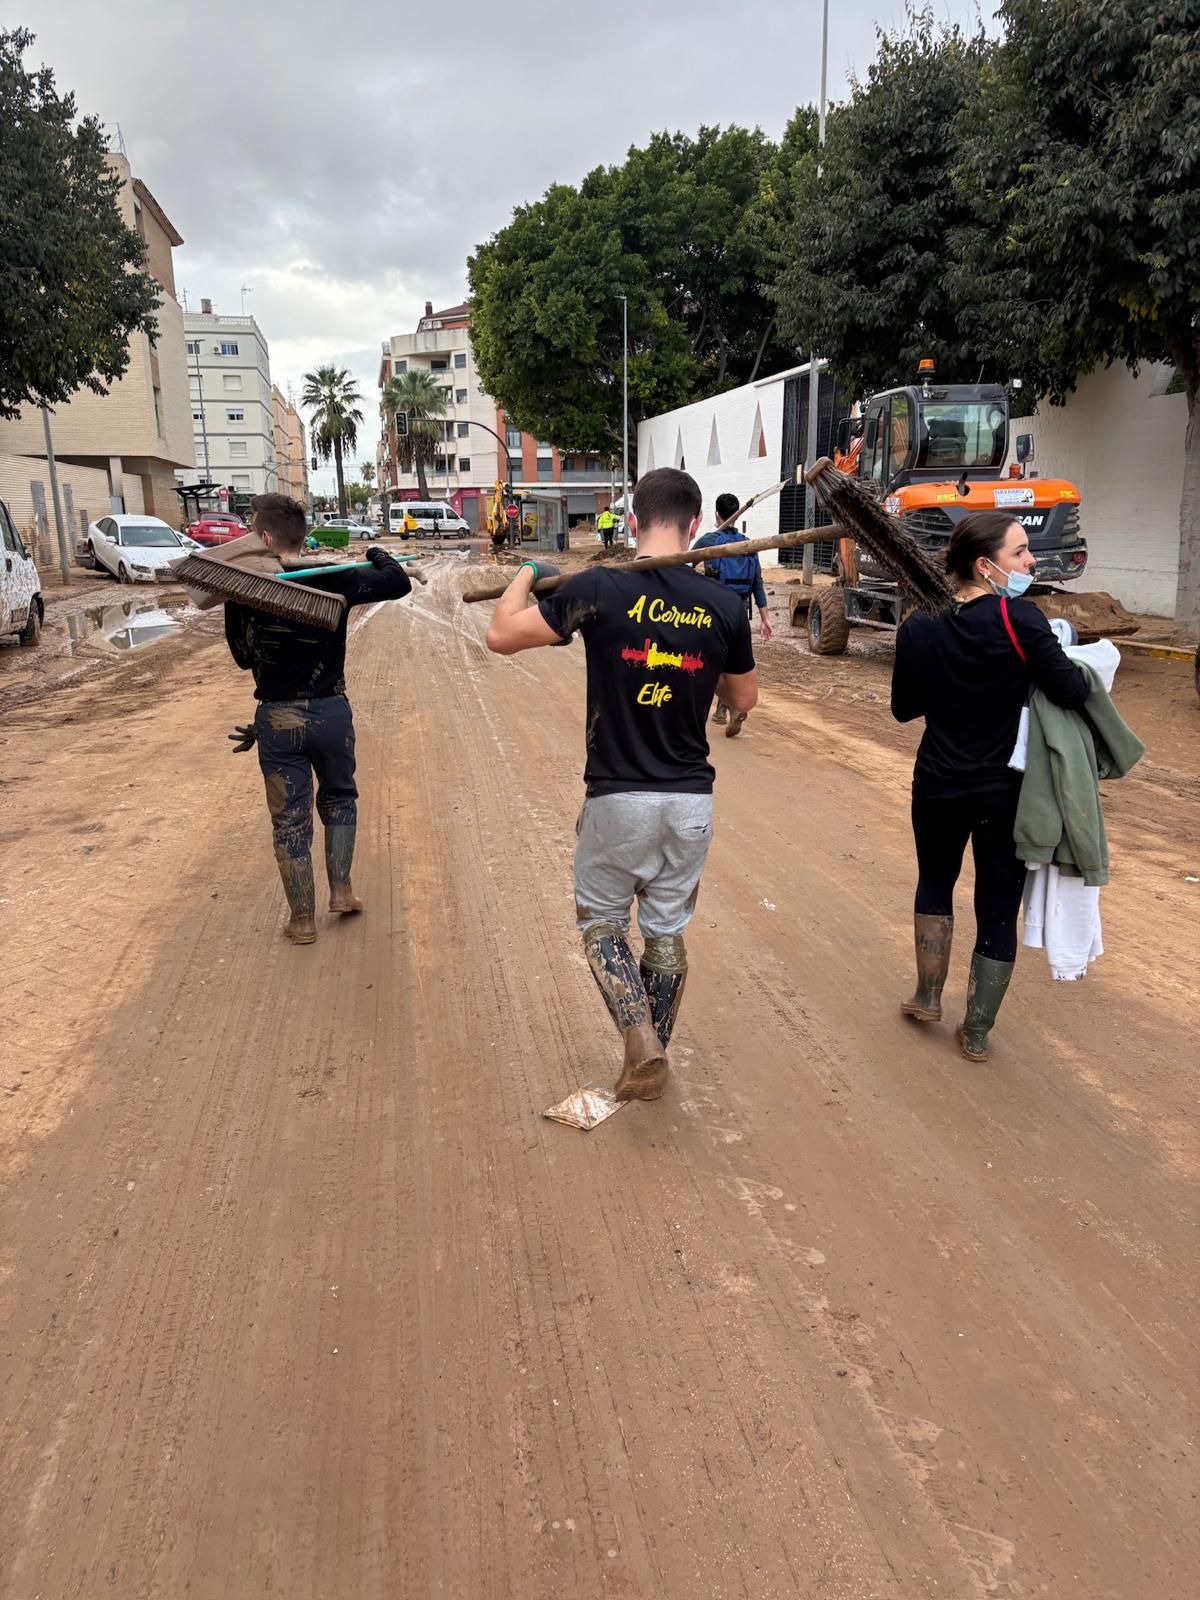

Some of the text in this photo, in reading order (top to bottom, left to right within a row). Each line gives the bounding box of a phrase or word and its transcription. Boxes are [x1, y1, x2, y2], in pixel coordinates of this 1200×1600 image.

[1015, 515, 1044, 526] SAN
[627, 594, 713, 629] A Coruña
[636, 682, 673, 708] Elite
